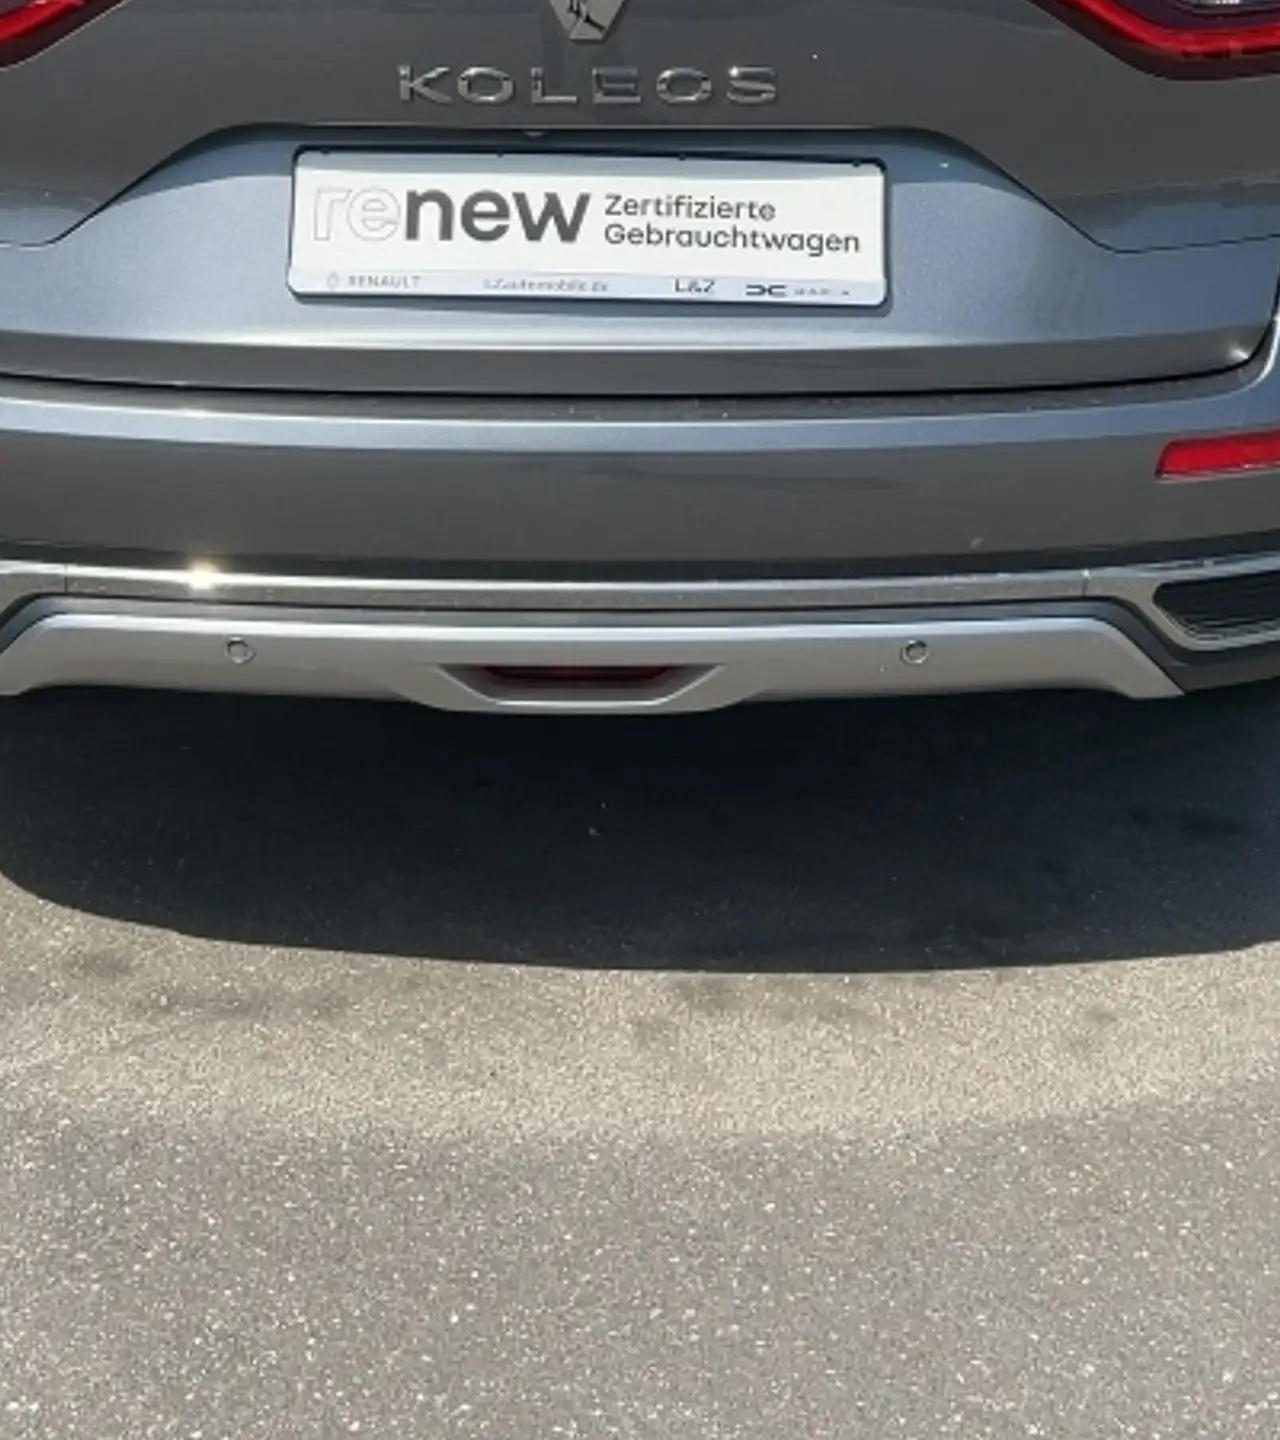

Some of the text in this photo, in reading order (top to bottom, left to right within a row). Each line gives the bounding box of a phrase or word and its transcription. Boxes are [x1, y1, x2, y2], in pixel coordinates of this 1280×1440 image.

[396, 65, 778, 106] KOLEOS
[312, 185, 591, 244] renew
[604, 193, 776, 222] Zertifizierte
[604, 223, 861, 257] Gebrauchtwagen
[348, 275, 421, 289] RENAULT
